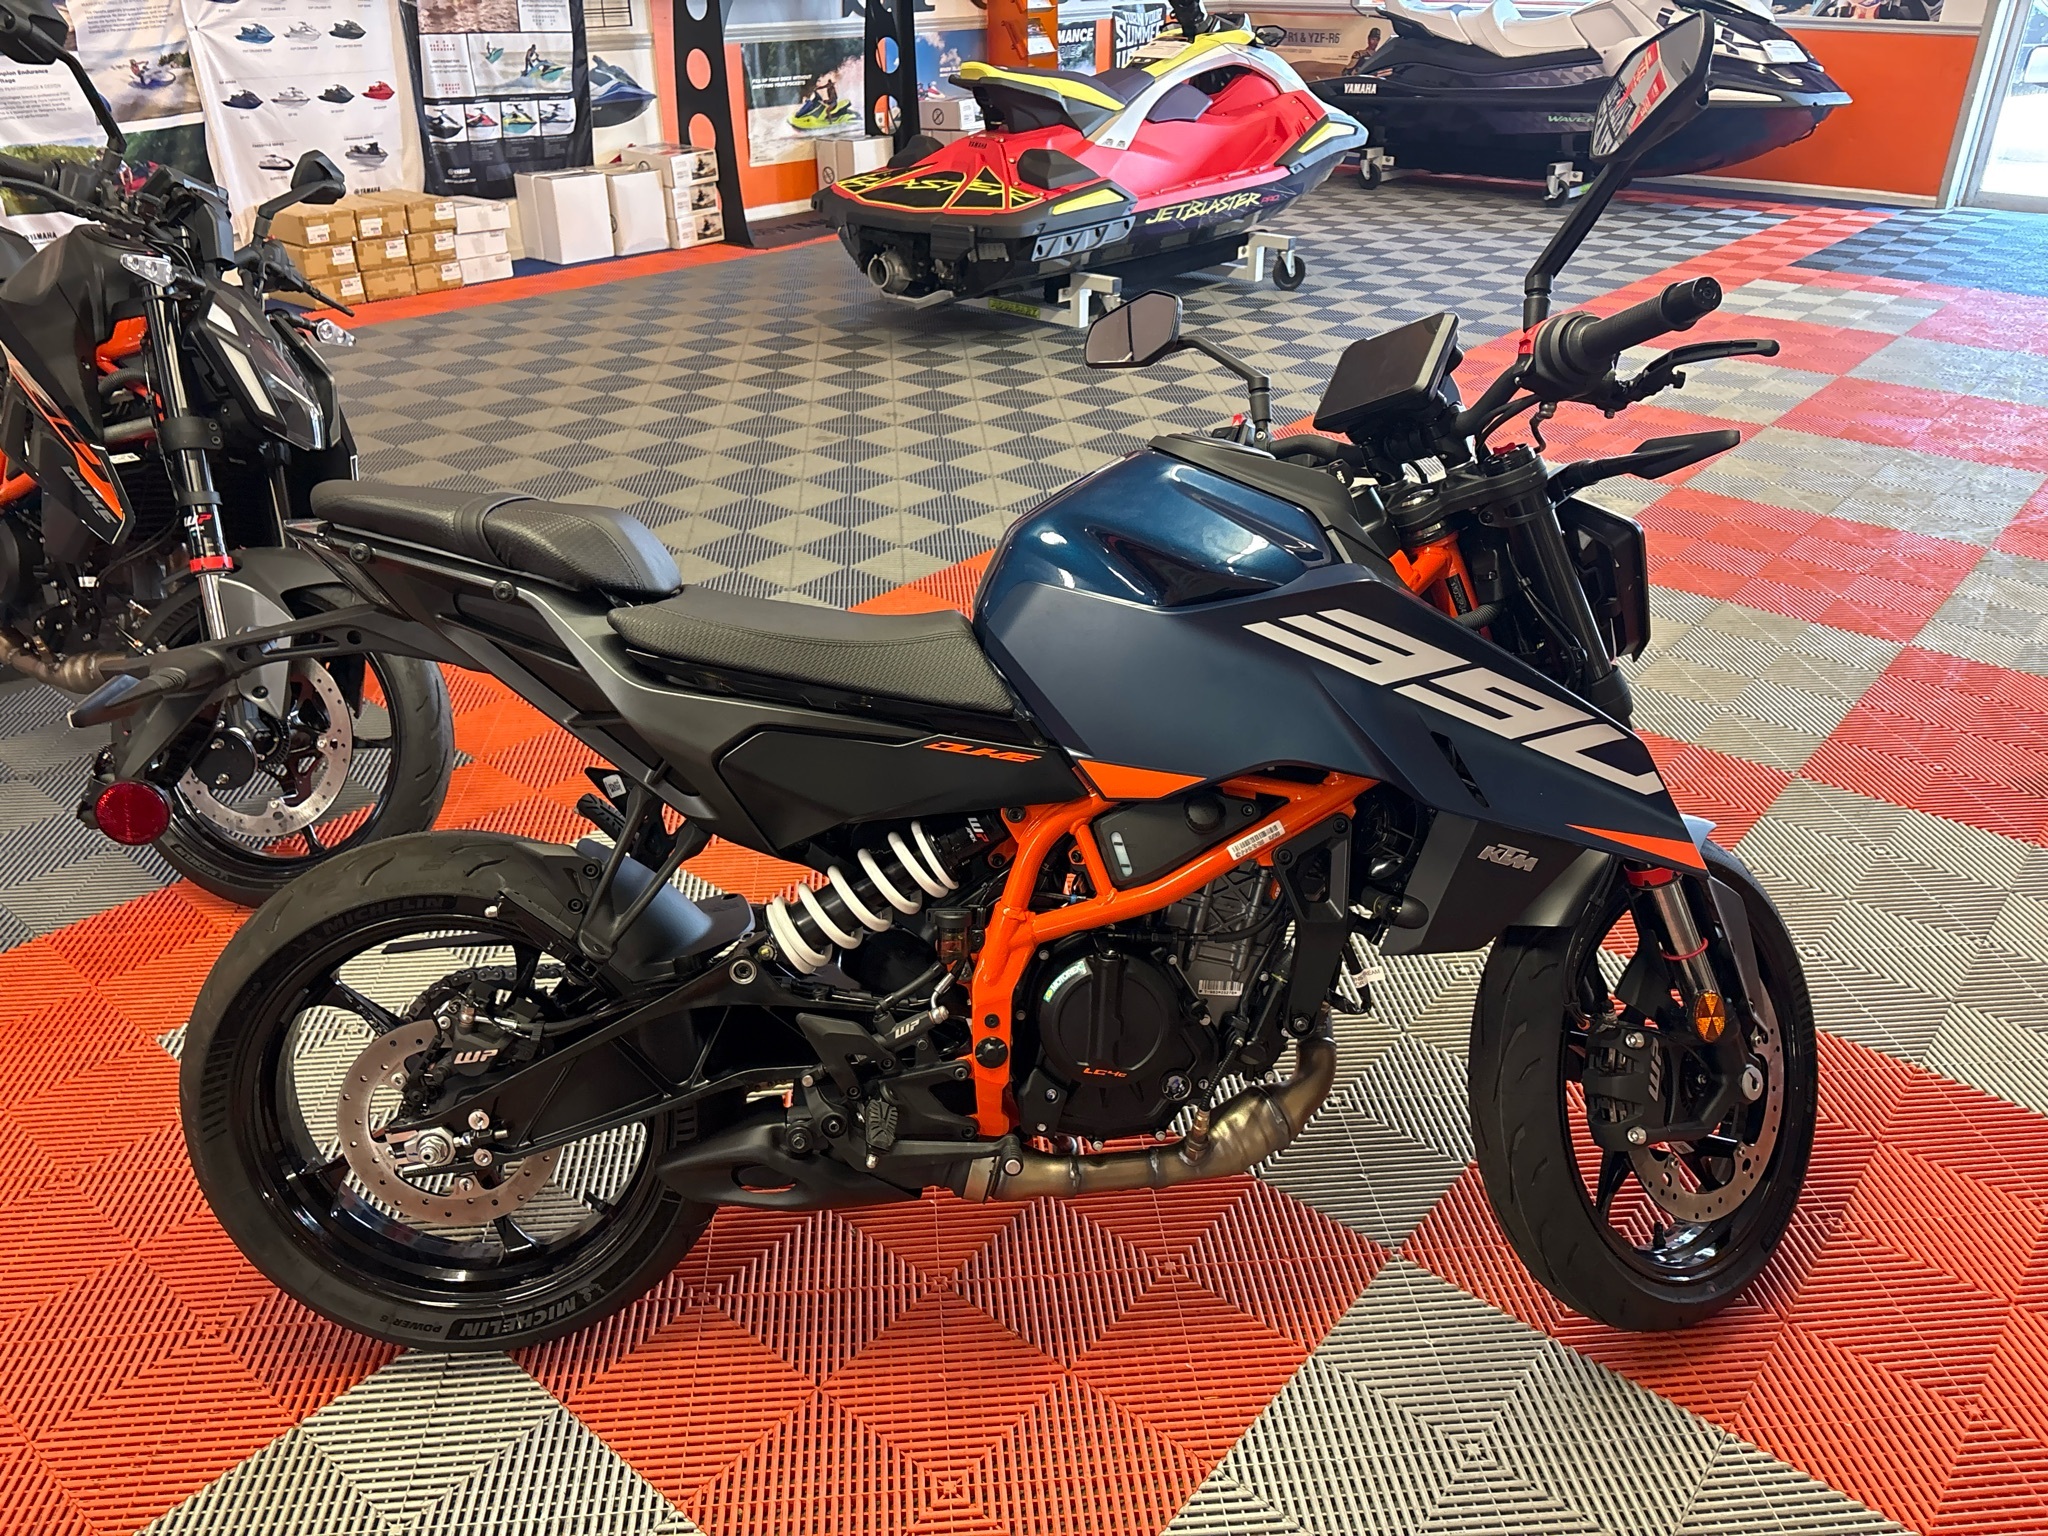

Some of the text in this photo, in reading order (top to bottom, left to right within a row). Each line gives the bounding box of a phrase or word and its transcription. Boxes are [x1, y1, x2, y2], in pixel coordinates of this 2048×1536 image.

[1309, 32, 1341, 44] YZF-R6
[1344, 83, 1377, 94] YAMAHA
[61, 465, 118, 525] DUKE
[923, 741, 1043, 763] DUKE
[1477, 842, 1539, 873] KTM
[323, 897, 446, 937] MICHELIN
[894, 1018, 921, 1039] WP
[453, 1048, 500, 1066] WP
[1647, 1037, 1662, 1101] WP
[393, 1318, 443, 1333] POWER
[459, 1294, 577, 1337] MICHELIN
